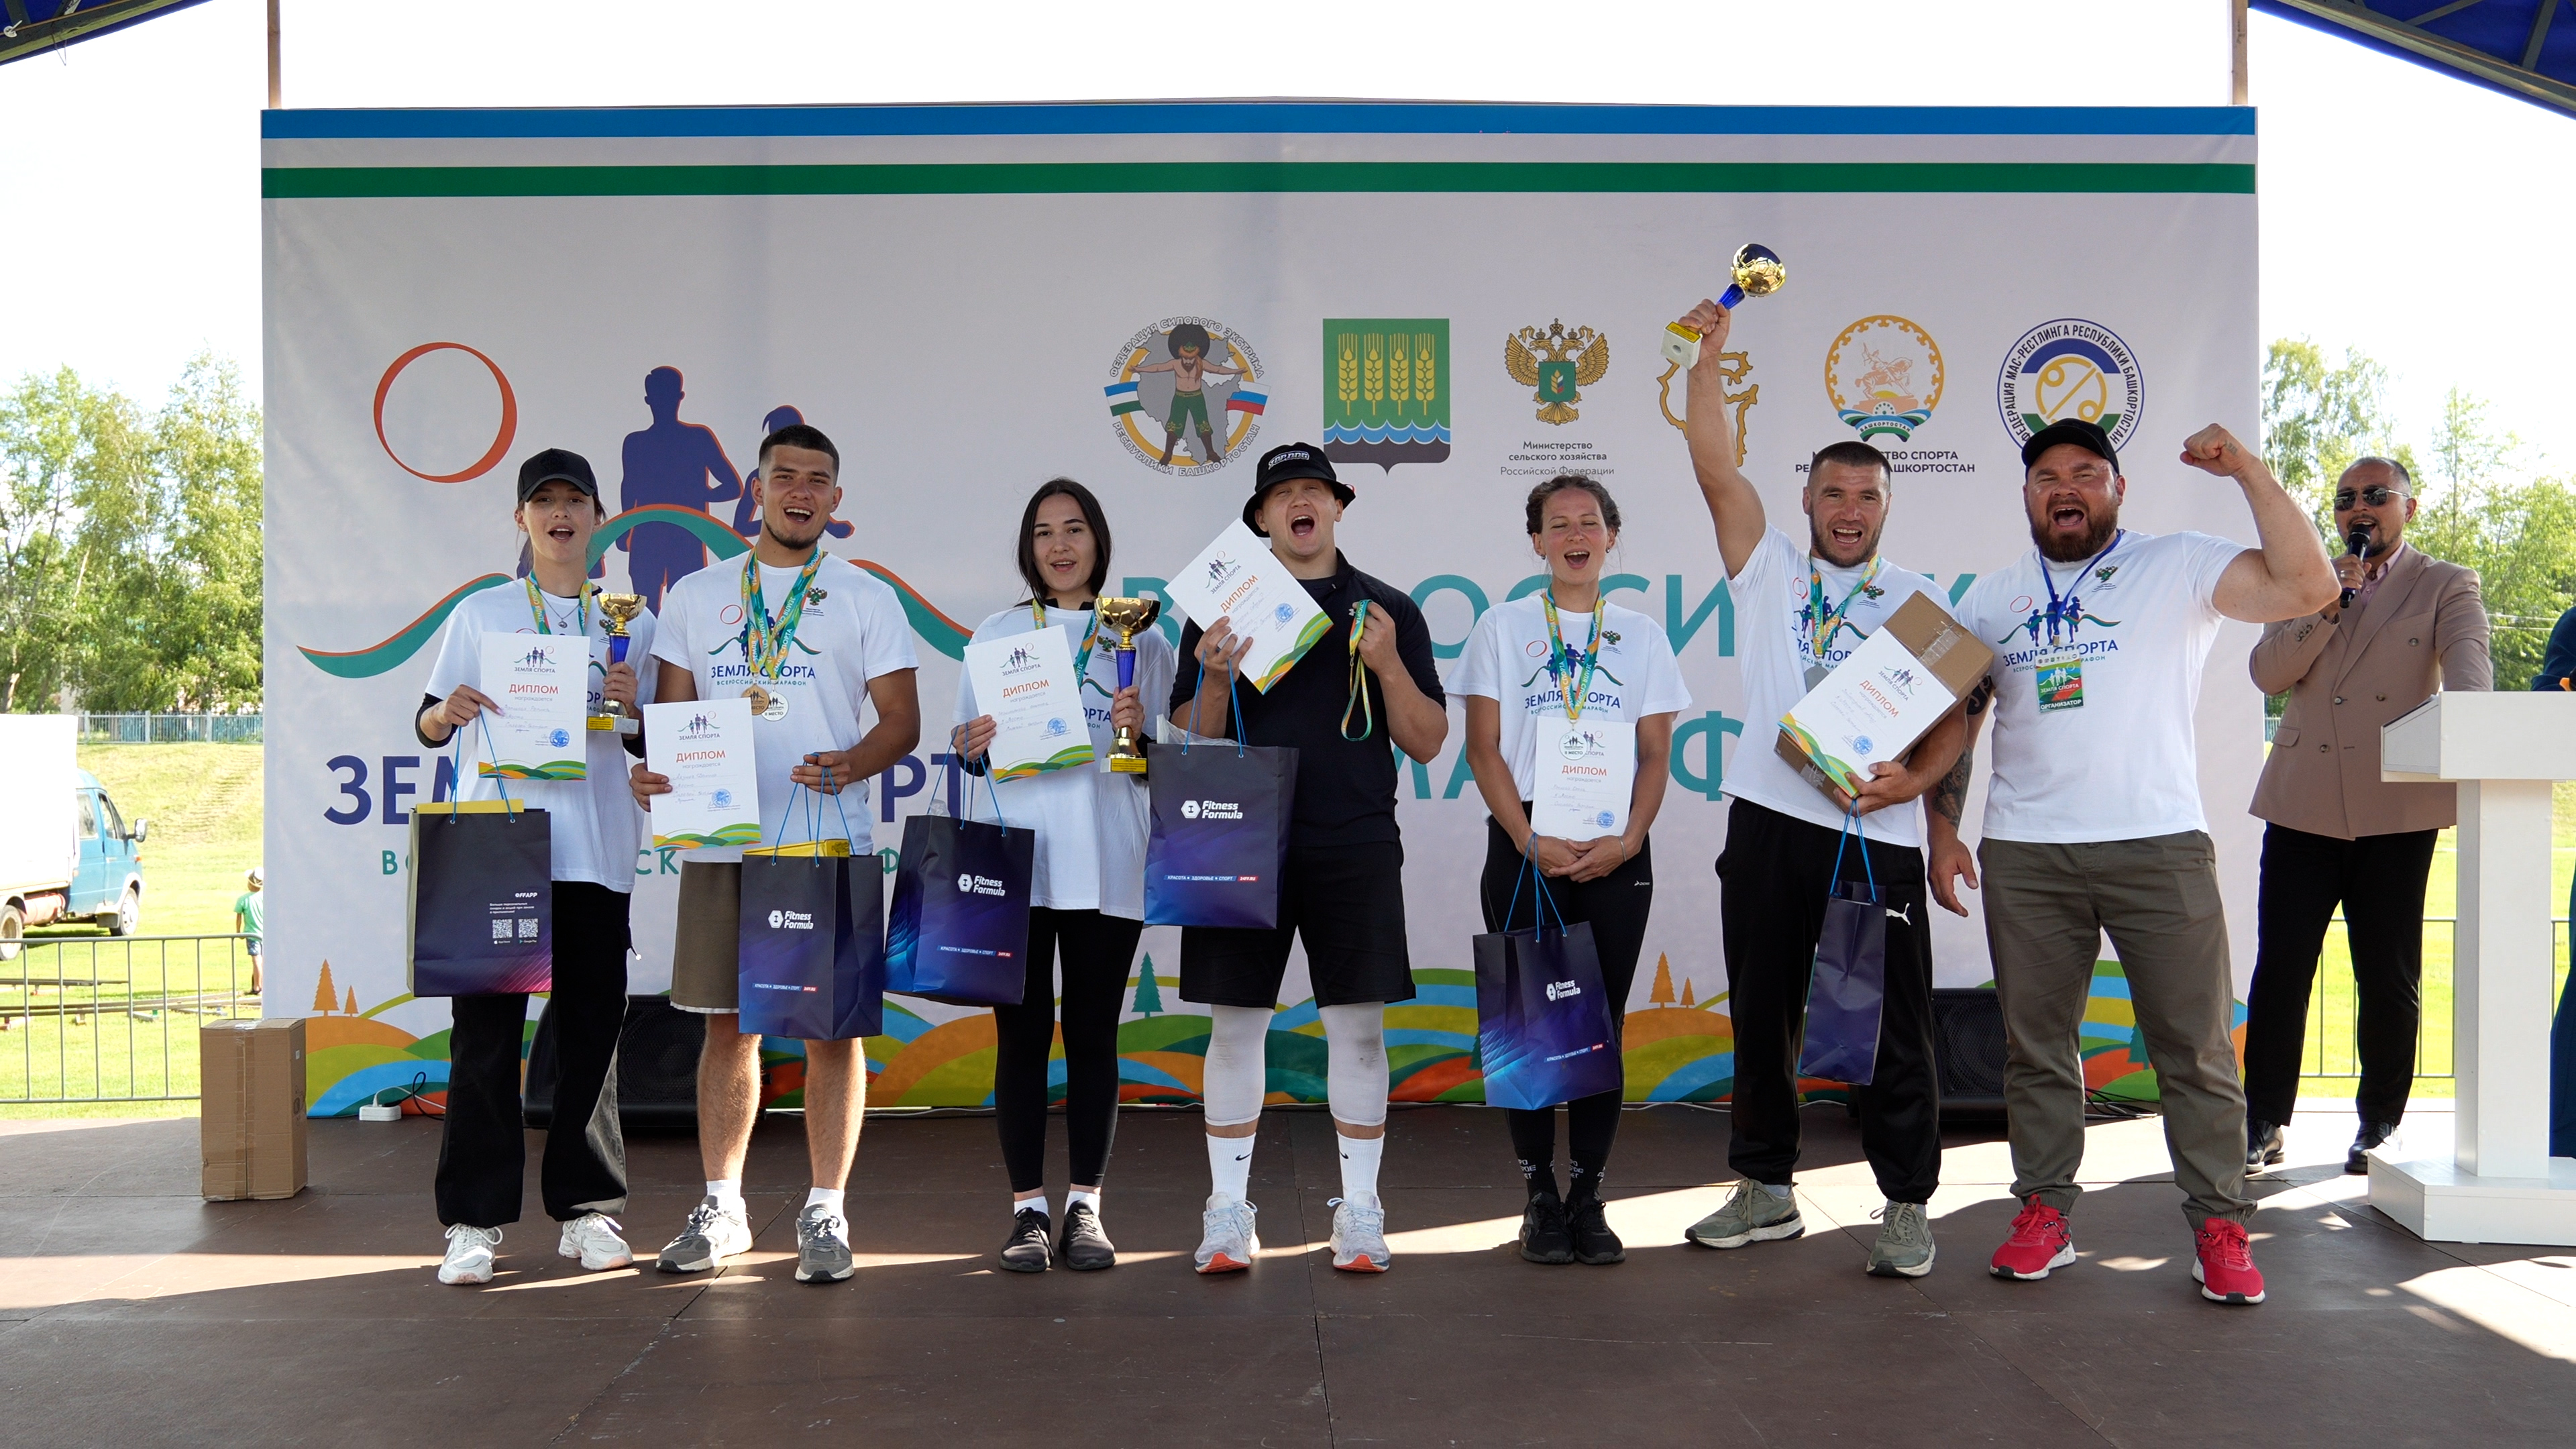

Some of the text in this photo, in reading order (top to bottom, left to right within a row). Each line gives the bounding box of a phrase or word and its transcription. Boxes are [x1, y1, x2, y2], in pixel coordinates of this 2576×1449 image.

[1110, 316, 1265, 379] ФЕДЕРАЦИЯ СИЛОВОГО ЭКСТРИМА
[2004, 325, 2139, 445] ФЕДЕРАЦИЯ МАС-РЕСТЛИНГА РЕСПУБЛИКИ БАШКОРТОСТАН
[1860, 421, 1911, 432] БАШКОРТОСТАН
[1112, 421, 1260, 476] РЕСПУБЛИКИ БАШКОРТОСТАН
[1523, 441, 1593, 451] Министерство
[1559, 453, 1607, 461] хозяйства
[1911, 451, 1958, 460] СПОРТА
[1500, 466, 1615, 476] Российской Федерации
[1210, 564, 1242, 594] ЗЕМЛЯ СПОРТА
[1220, 575, 1258, 613] ДИПЛОМ
[783, 596, 796, 615] ЗЕМЛЯ
[1355, 601, 1365, 625] СПОРТА
[758, 617, 766, 638] ЗЕМЛЯ
[782, 629, 792, 653] СПОРТА
[1002, 664, 1041, 676] ЗЕМЛЯ СПОРТА
[1584, 663, 1592, 683] ЗЕМЛЯ
[508, 684, 559, 694] ДИПЛОМ
[1003, 680, 1050, 698] ДИПЛОМ
[1559, 661, 1574, 707] ЗЕМЛЯ СПОРТА
[1878, 671, 1909, 701] ЗЕМЛЯ СПОРТА
[1525, 690, 1563, 708] ЗЕМЛЯ
[1860, 680, 1899, 718] ДИПЛОМ
[2041, 699, 2082, 710] ОРГАНИЗАТОР
[676, 750, 726, 763] ДИПЛОМ
[1562, 765, 1607, 776] ДИПЛОМ
[1201, 800, 1239, 810] Fitness
[1201, 810, 1243, 819] Formula
[973, 875, 1003, 887] Fitness
[973, 885, 1006, 896] Formula
[784, 910, 812, 920] Fitness
[784, 920, 814, 929] Formula
[1556, 979, 1575, 990] Fitness
[1557, 986, 1581, 999] Formula
